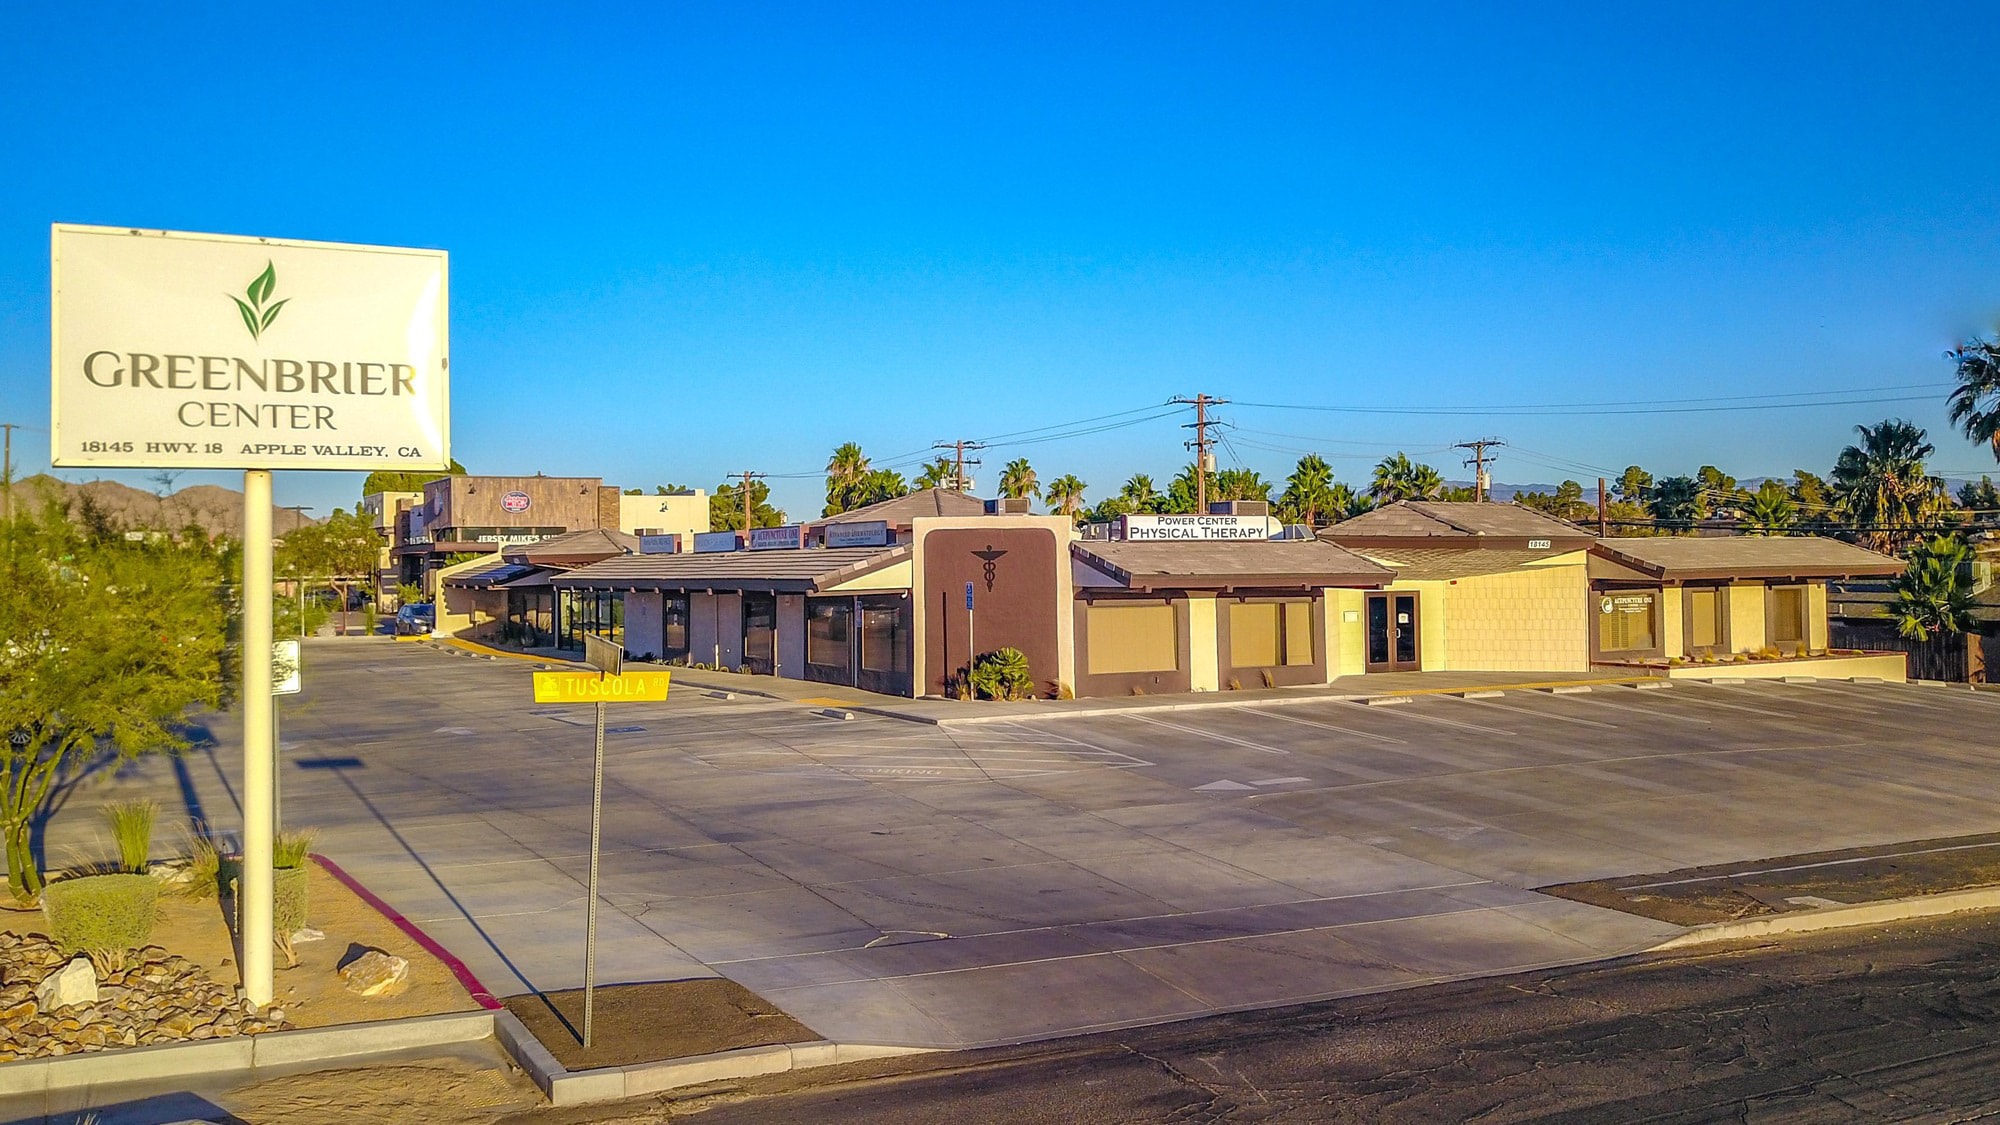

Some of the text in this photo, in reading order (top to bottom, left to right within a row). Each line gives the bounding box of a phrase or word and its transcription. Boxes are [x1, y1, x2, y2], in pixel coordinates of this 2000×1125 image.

[83, 350, 416, 396] GREENBRIER
[178, 401, 338, 430] CENTER
[81, 441, 134, 452] 18145
[145, 442, 198, 453] HWY.
[204, 442, 223, 453] 18
[240, 444, 307, 456] APPLE
[397, 446, 422, 458] CA
[478, 535, 508, 543] JERSEY
[565, 678, 665, 696] TUSCOLA RD
